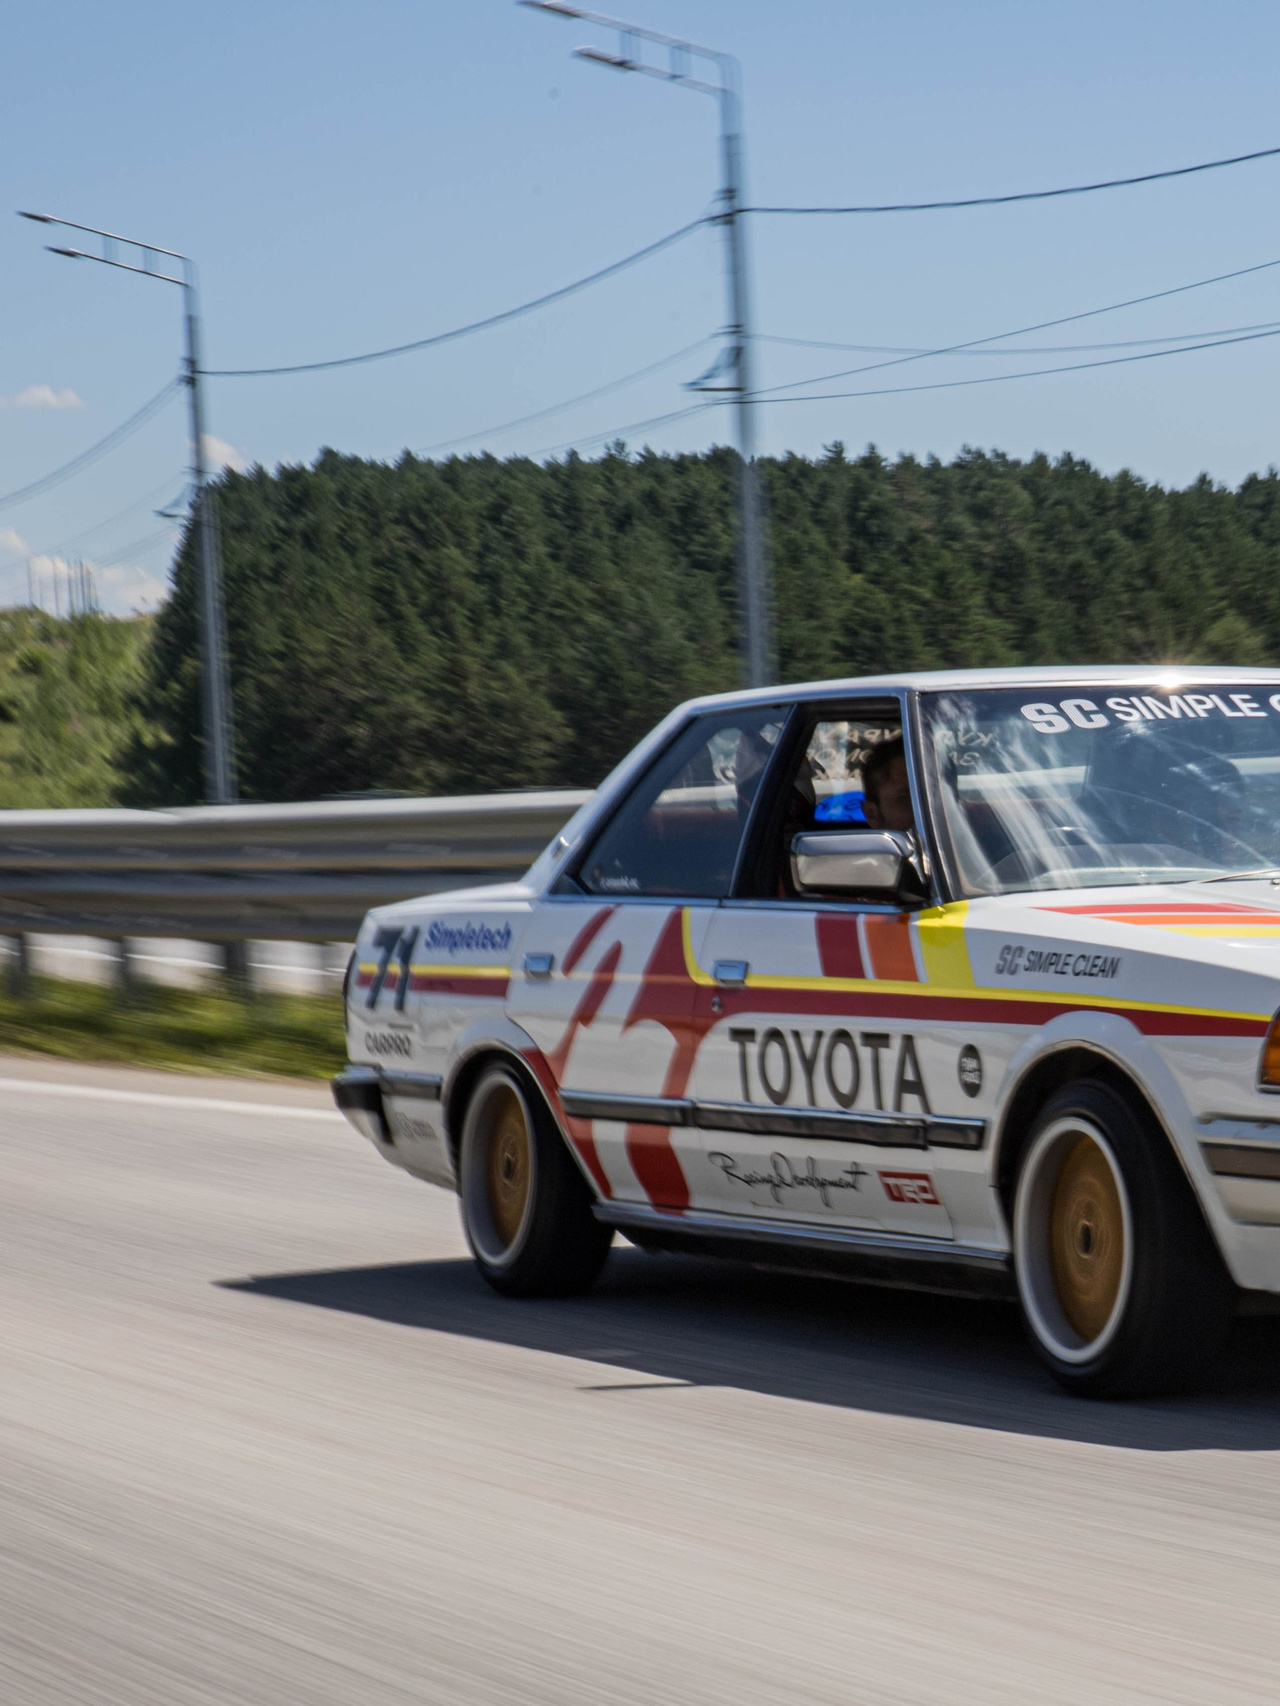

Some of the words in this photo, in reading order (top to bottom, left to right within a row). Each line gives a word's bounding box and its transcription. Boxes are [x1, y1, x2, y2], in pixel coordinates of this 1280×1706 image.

[1020, 698, 1110, 734] SC
[1105, 693, 1269, 723] SIMPLE
[365, 925, 421, 1012] 71
[995, 944, 1025, 976] SC
[1023, 949, 1073, 975] SIMPLE
[1072, 952, 1121, 978] CLEAN
[729, 1027, 931, 1114] TOYOTA
